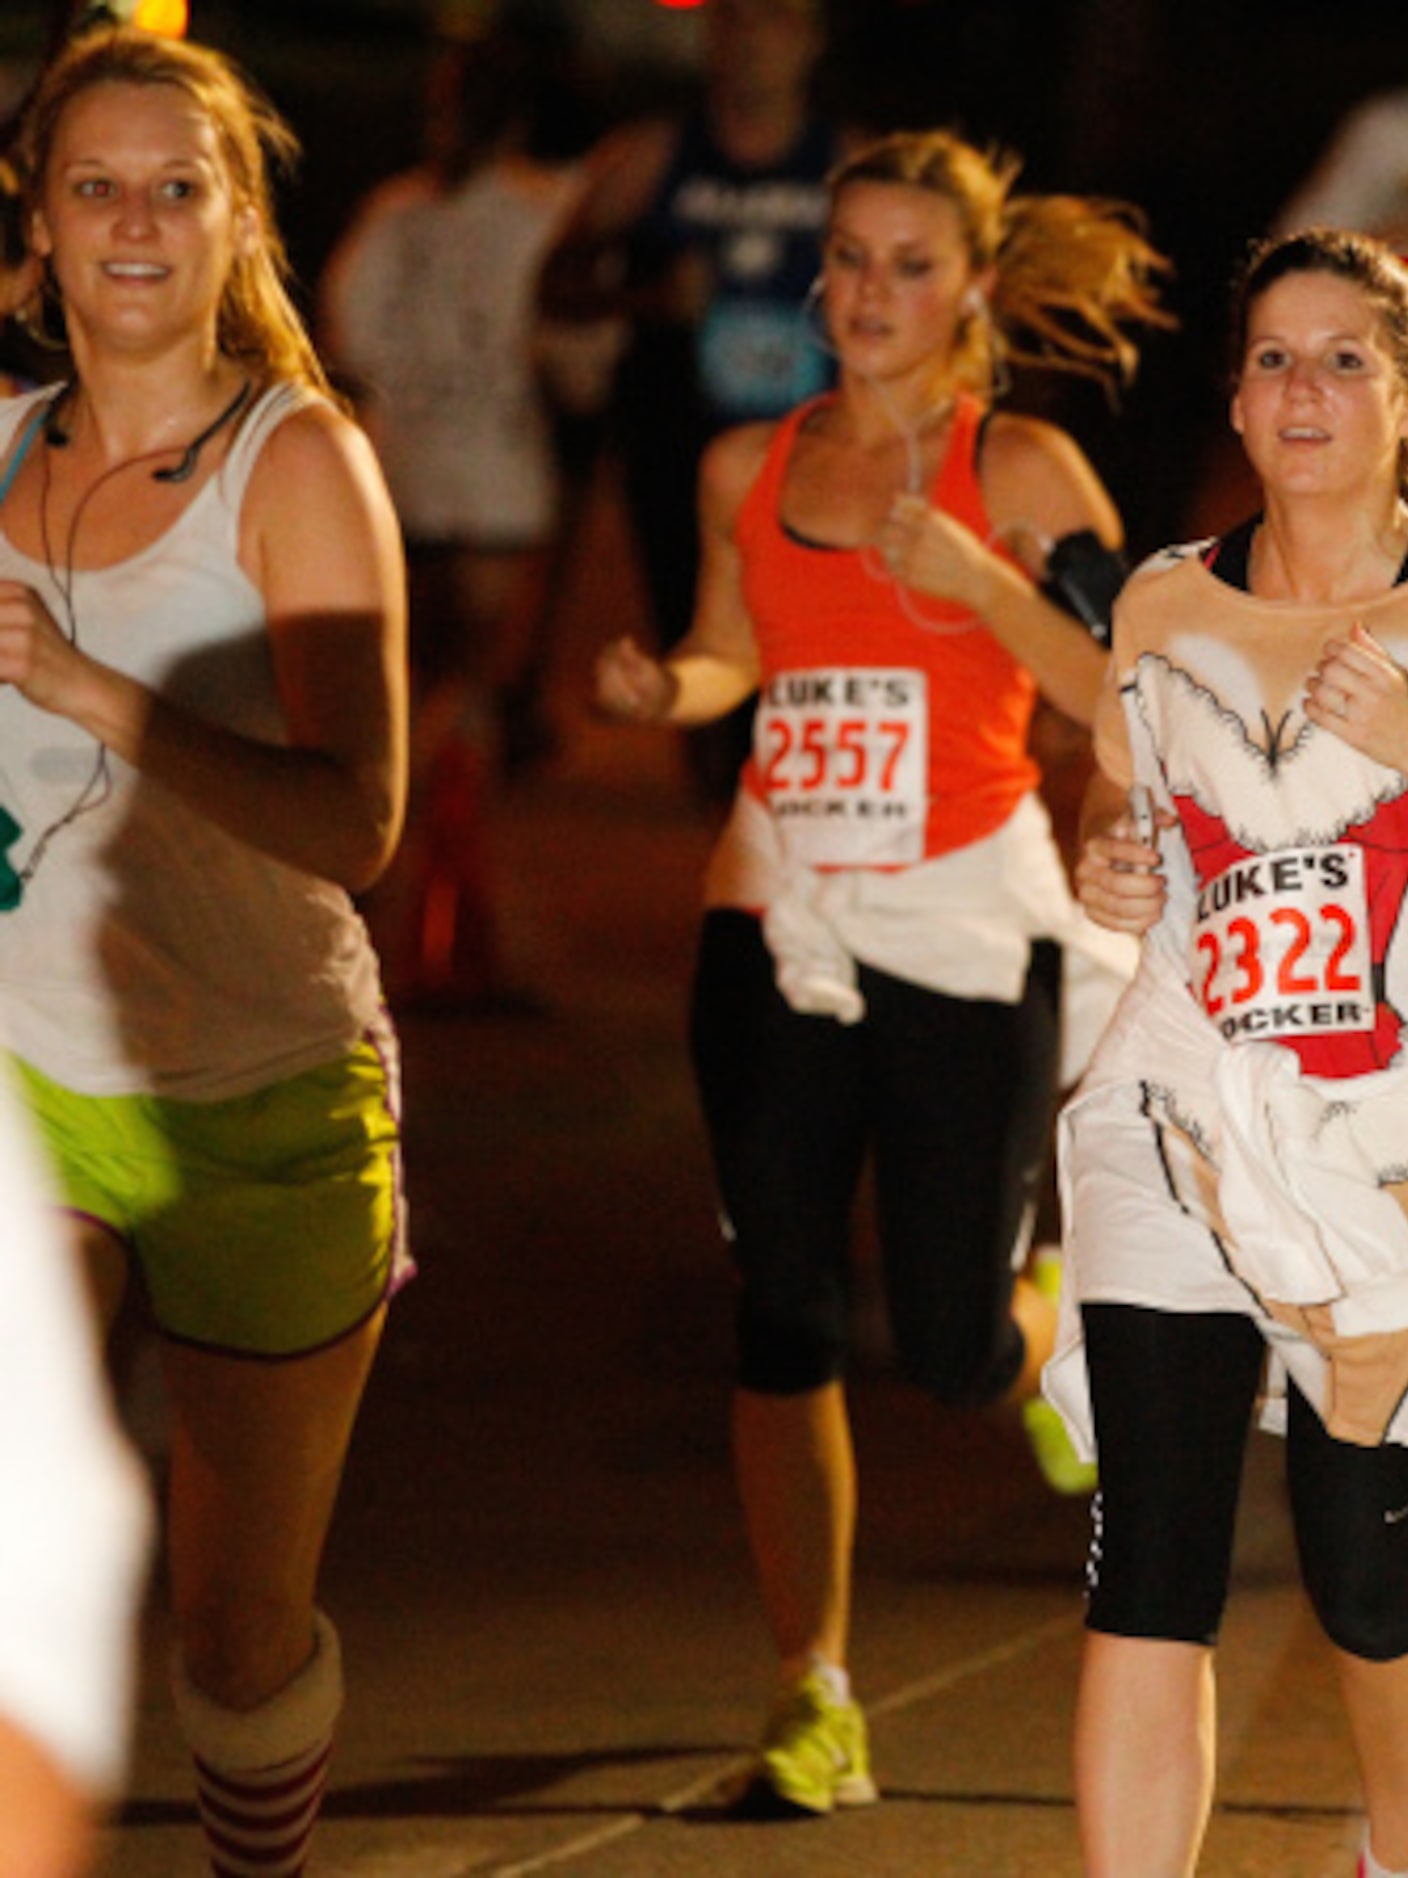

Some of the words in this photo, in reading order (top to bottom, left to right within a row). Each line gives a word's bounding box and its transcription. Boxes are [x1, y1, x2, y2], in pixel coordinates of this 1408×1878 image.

[769, 676, 910, 707] LUKE'S
[765, 719, 911, 793] 2557
[1196, 853, 1349, 922] LUKE'S
[1196, 902, 1361, 1018] 2322
[1220, 1002, 1361, 1042] OCKER
